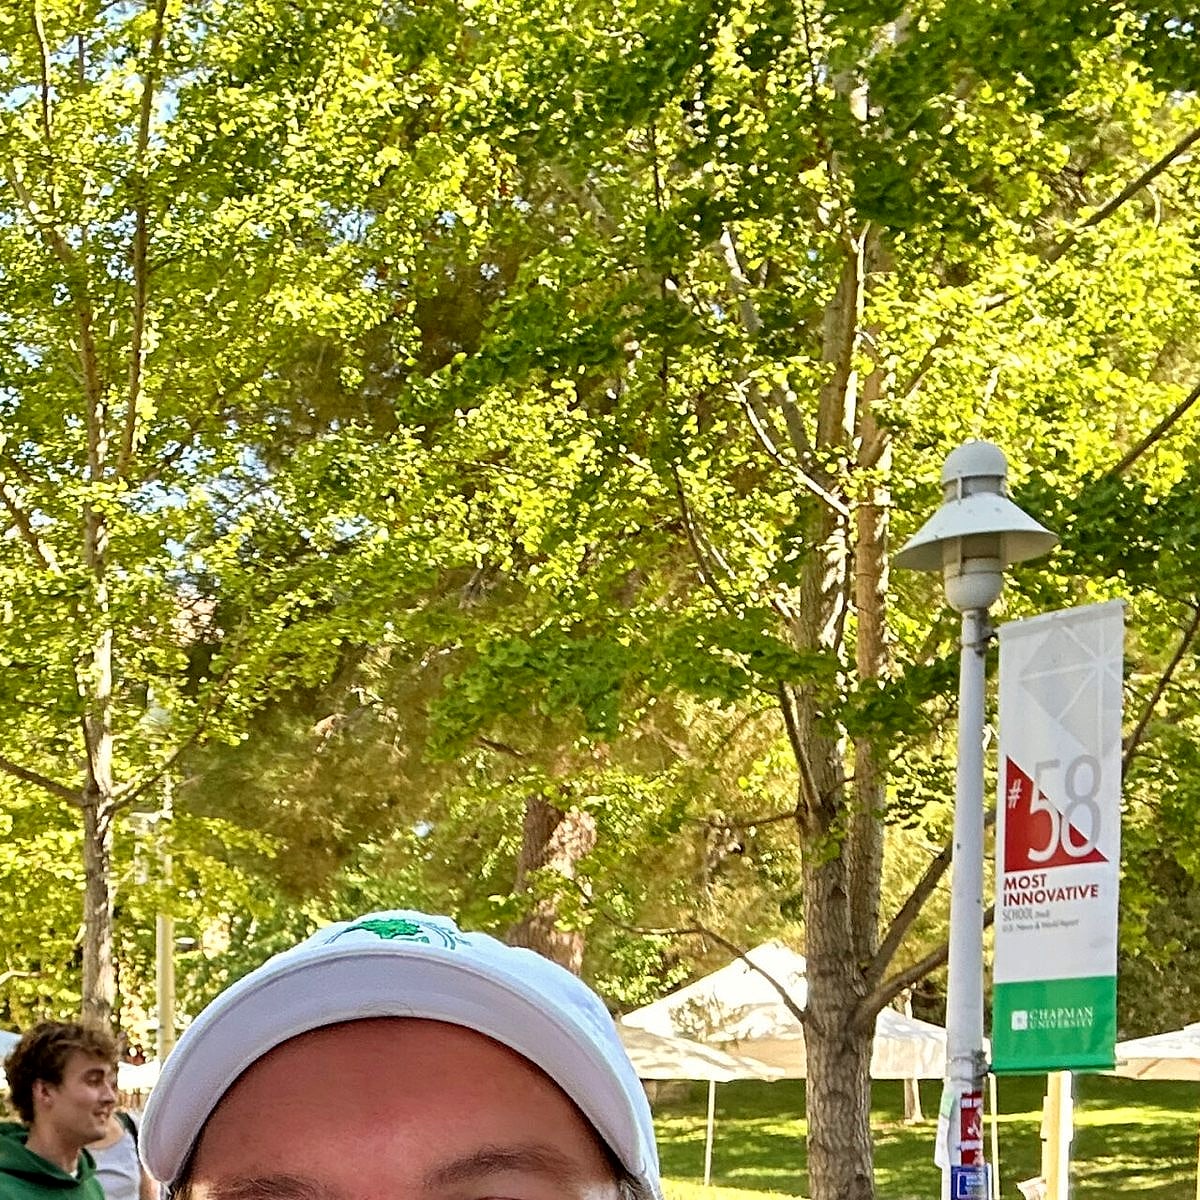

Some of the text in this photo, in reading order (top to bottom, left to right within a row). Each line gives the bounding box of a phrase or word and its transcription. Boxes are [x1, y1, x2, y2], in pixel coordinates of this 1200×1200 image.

[1003, 873, 1047, 891] MOST
[1003, 884, 1099, 907] INNOVATIVE
[1002, 907, 1033, 921] SCHOOL
[1029, 1007, 1094, 1020] CHAPMAN
[1029, 1018, 1095, 1029] UNIVERSITY
